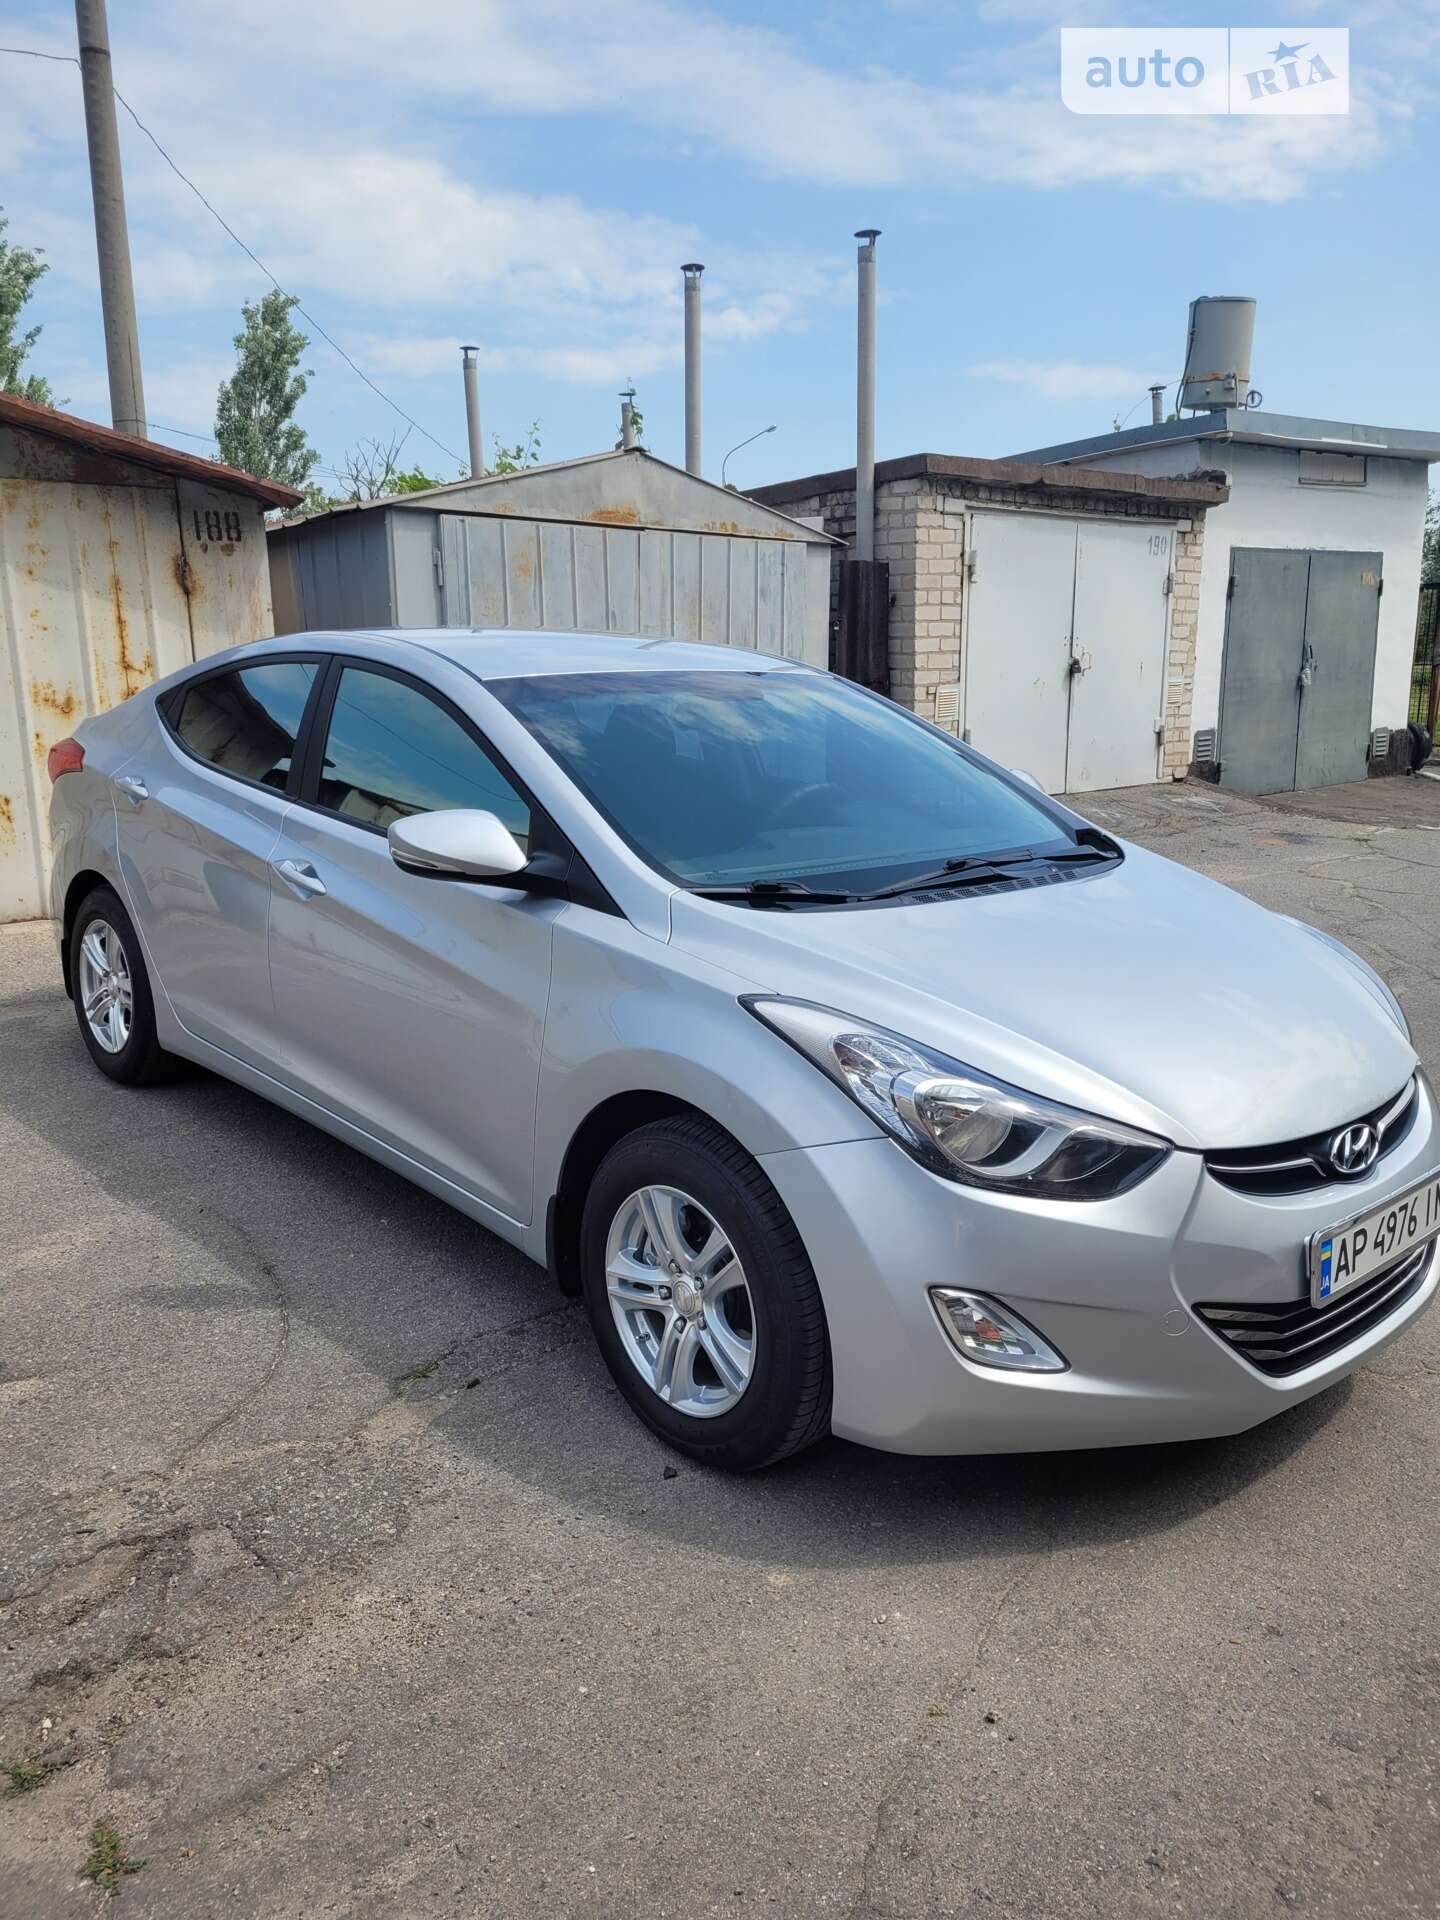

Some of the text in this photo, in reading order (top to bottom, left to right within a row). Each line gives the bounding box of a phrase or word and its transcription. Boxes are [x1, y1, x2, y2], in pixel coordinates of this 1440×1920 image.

[193, 510, 242, 542] 188
[1147, 535, 1167, 556] 190
[1334, 1227, 1368, 1283] AP
[1373, 1196, 1418, 1256] 4976
